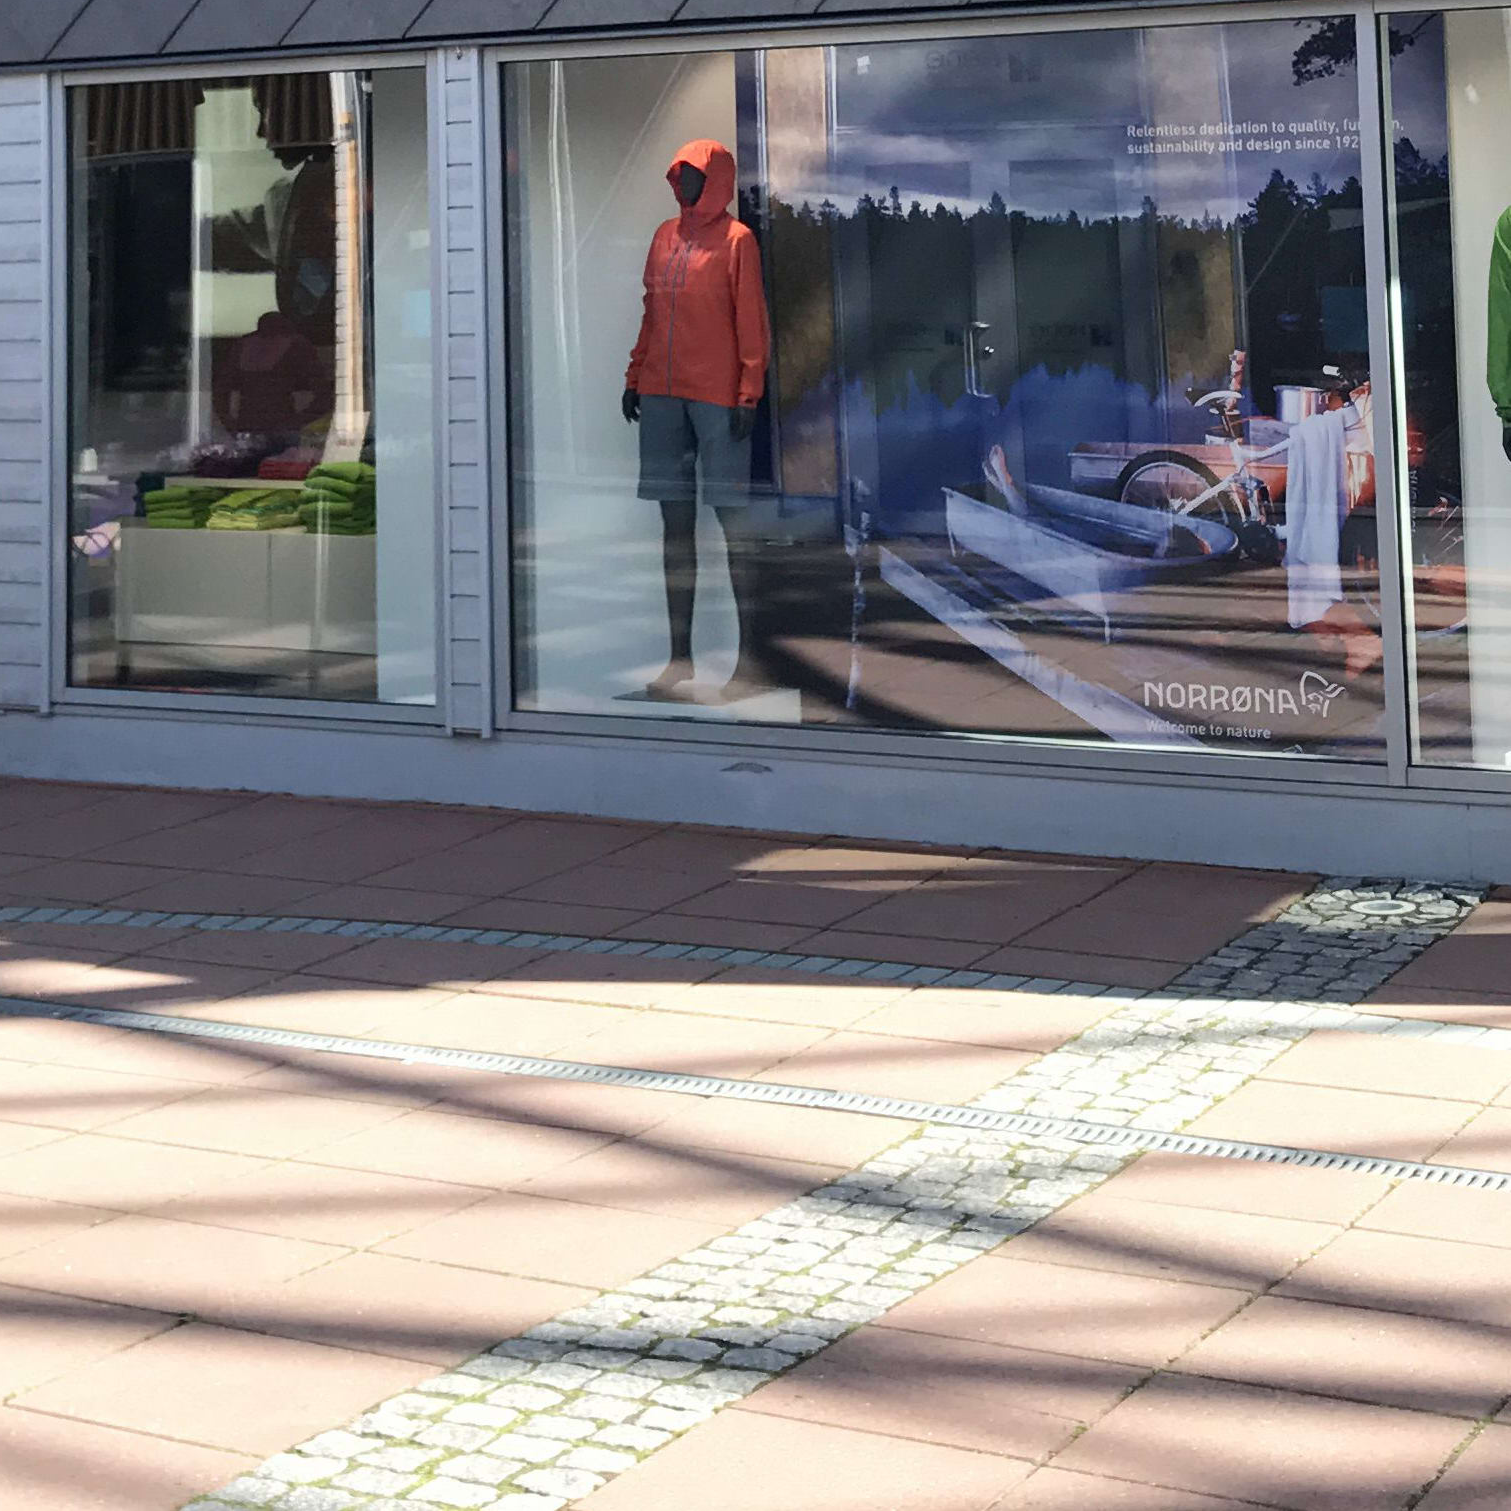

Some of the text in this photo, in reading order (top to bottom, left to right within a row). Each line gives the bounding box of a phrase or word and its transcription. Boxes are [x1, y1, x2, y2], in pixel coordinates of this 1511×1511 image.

[1126, 124, 1196, 138] Relentless
[1199, 121, 1268, 136] dedication
[1272, 121, 1285, 133] to
[1288, 118, 1339, 136] quality,
[1127, 135, 1359, 155] sustainability and design since 192
[1143, 681, 1300, 716] NORRØNA
[1146, 719, 1272, 739] Welcome to nature
